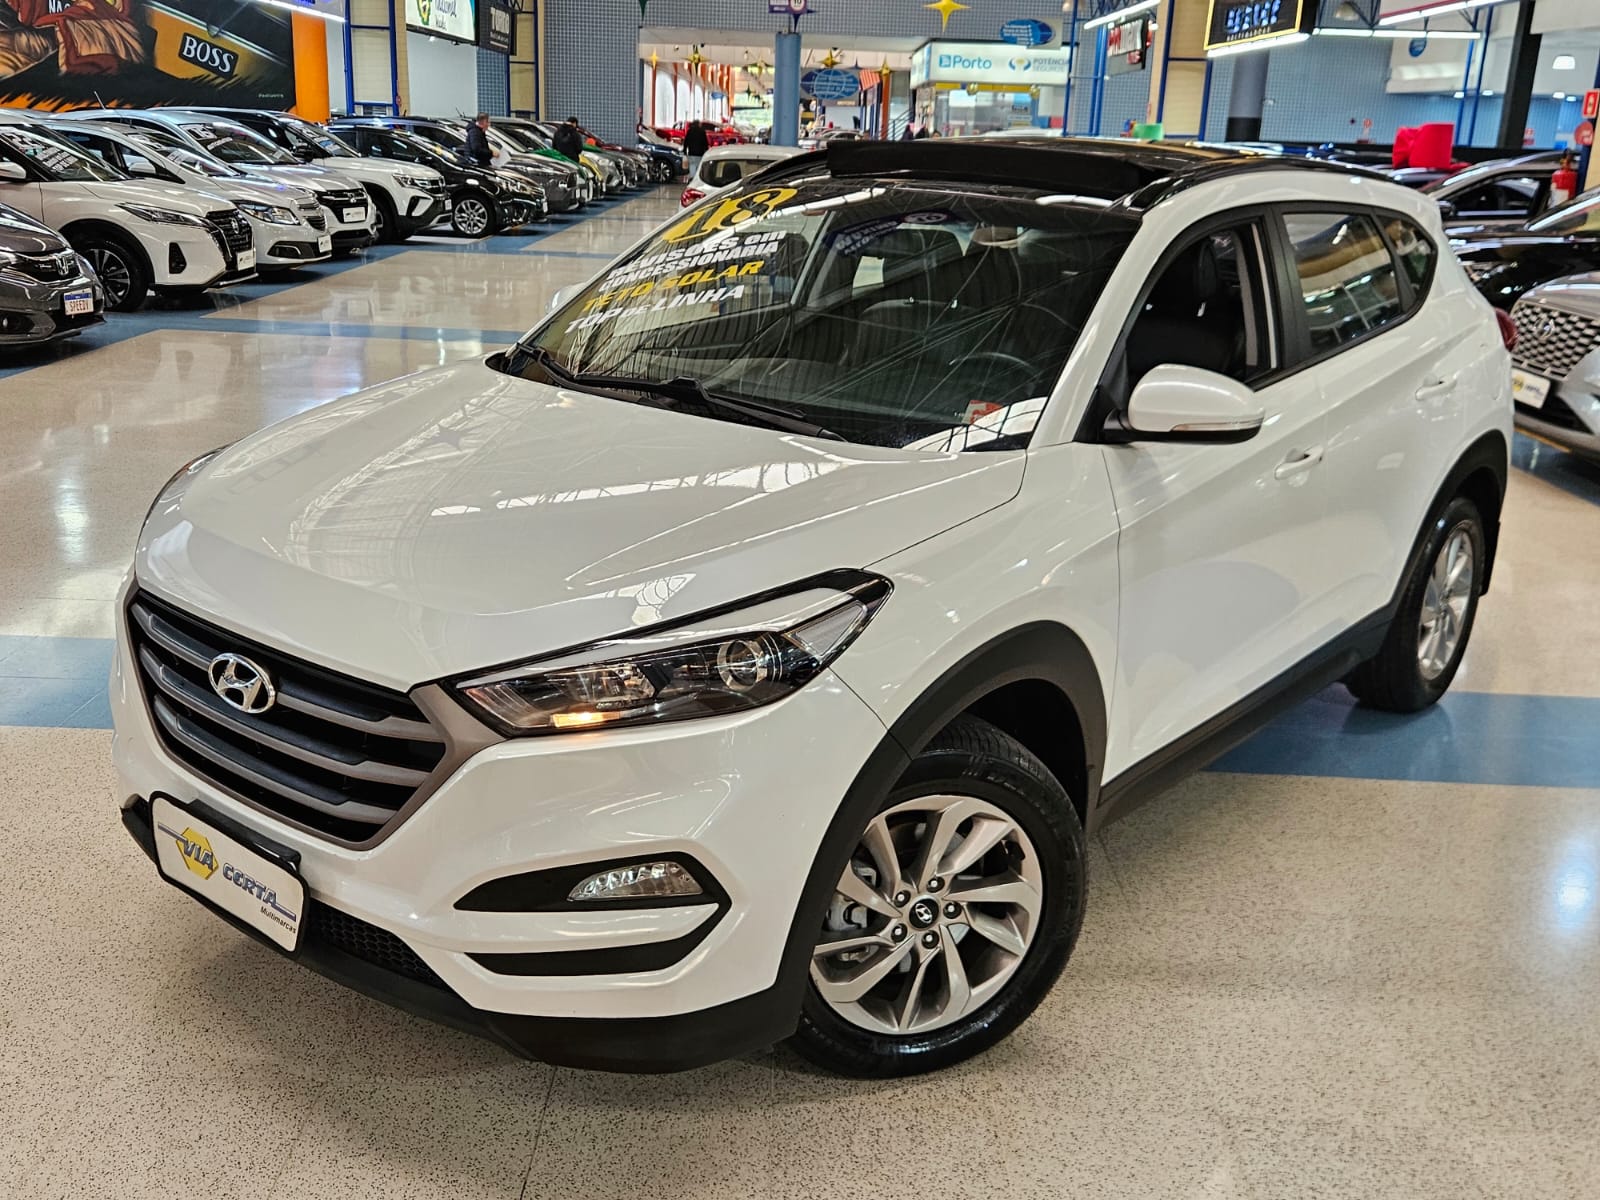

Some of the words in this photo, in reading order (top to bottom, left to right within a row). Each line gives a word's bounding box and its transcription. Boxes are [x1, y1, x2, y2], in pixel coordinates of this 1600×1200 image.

[183, 36, 235, 74] BOSS
[953, 55, 992, 69] Porto
[662, 187, 798, 243] 18
[565, 307, 618, 335] TOP
[650, 284, 746, 313] LINHA
[582, 281, 655, 313] TETO
[657, 260, 766, 290] SOLAR
[183, 839, 214, 871] VIA
[222, 862, 278, 907] CERTA
[261, 906, 297, 934] Multimarcas
